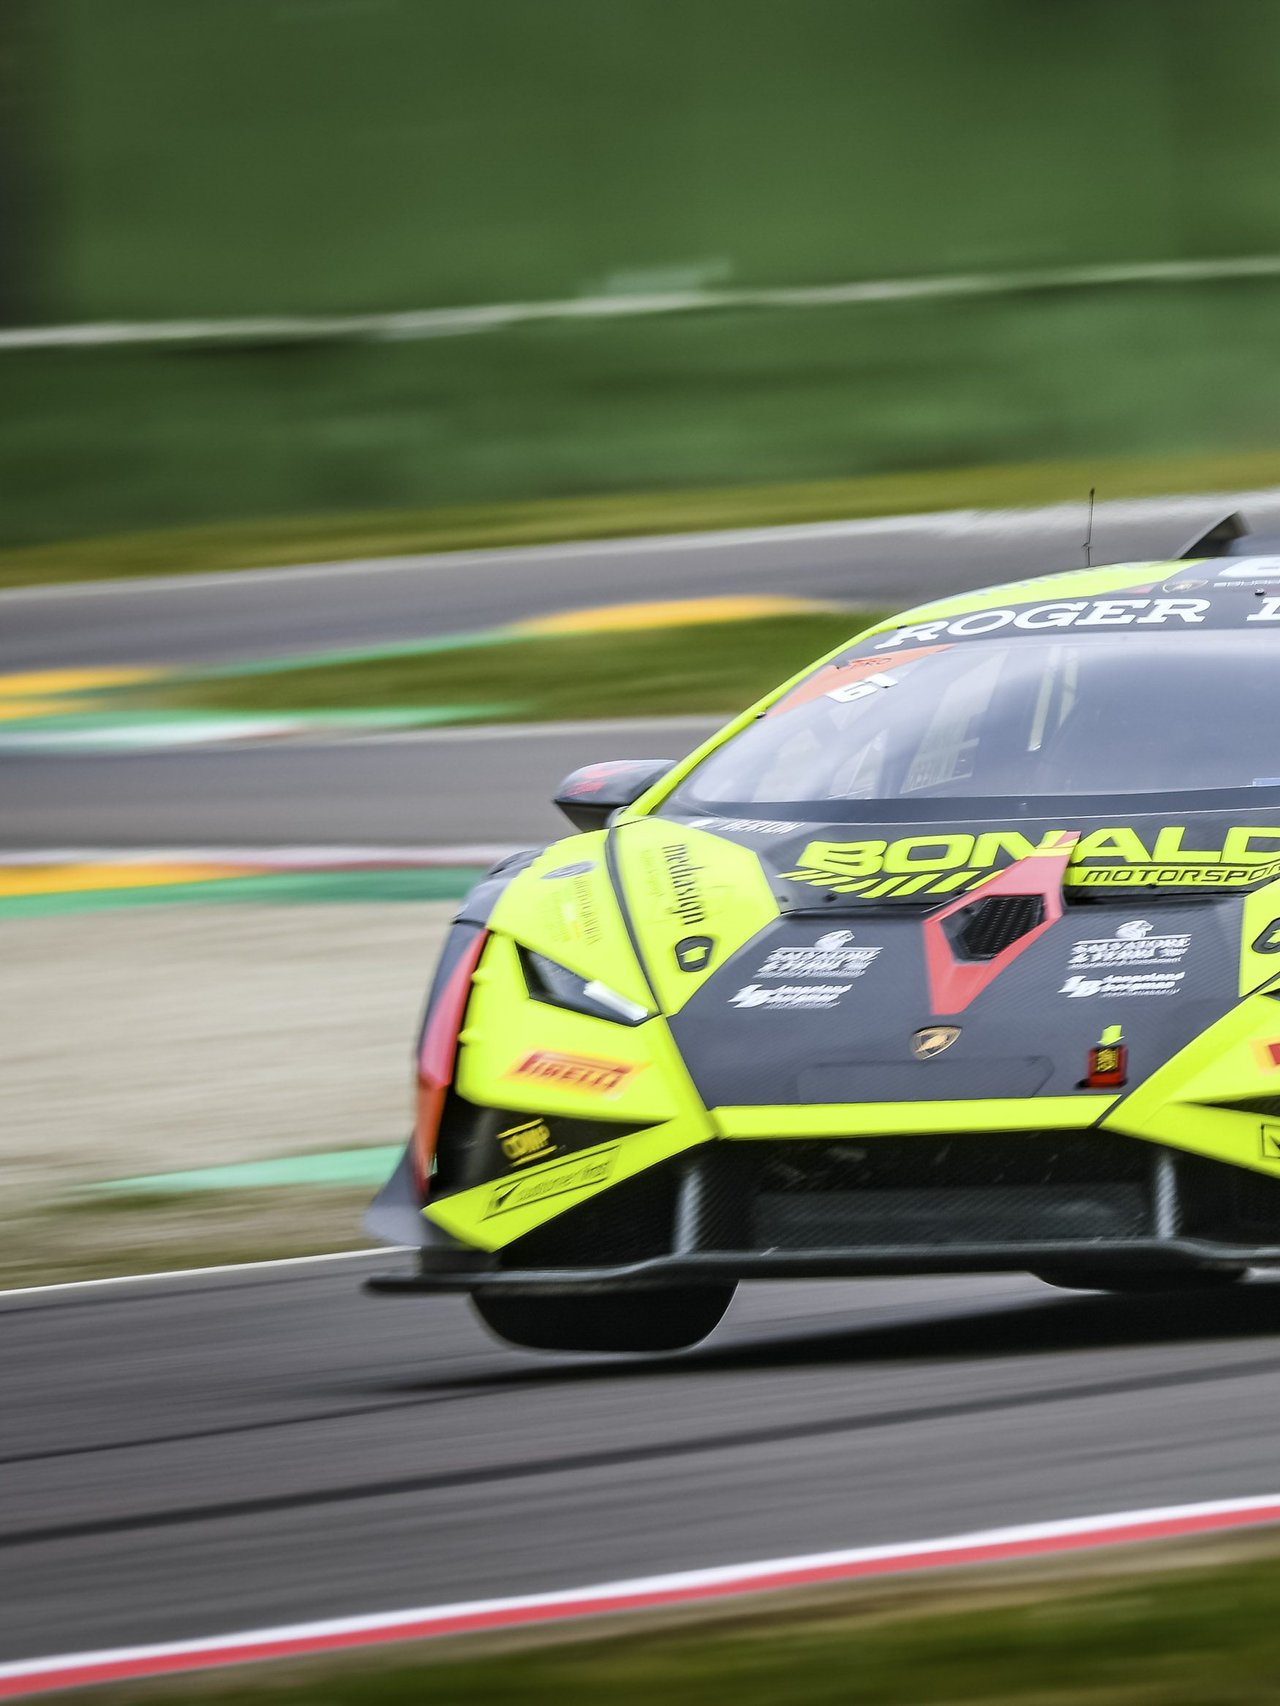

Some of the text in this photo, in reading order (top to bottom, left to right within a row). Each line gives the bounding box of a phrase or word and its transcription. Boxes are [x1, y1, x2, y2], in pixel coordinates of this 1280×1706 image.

[872, 597, 1212, 651] ROGER
[824, 672, 899, 704] 61
[517, 1052, 633, 1090] PIRELLI
